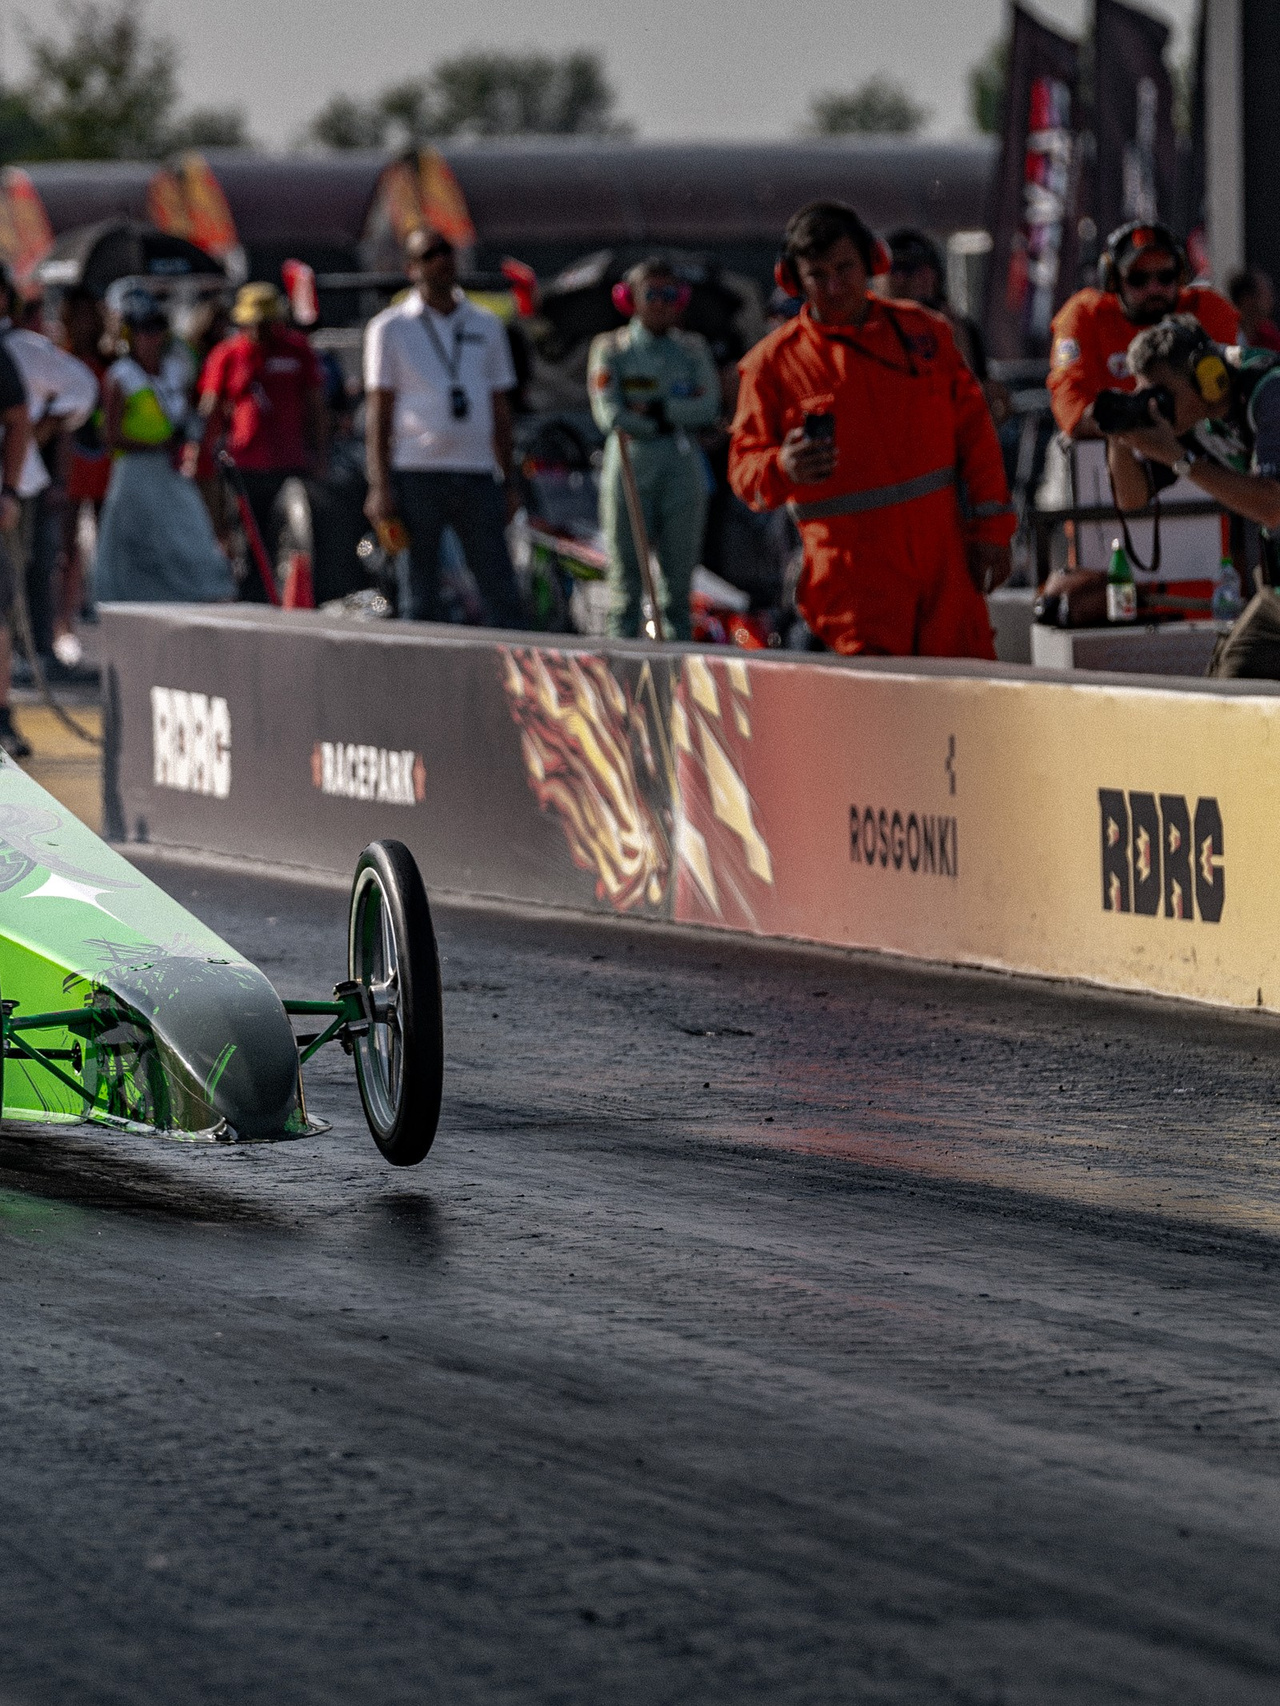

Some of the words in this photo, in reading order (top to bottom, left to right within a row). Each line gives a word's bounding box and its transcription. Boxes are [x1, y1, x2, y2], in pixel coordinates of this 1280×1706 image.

[150, 685, 232, 800] RDRC
[321, 741, 417, 807] RACEPARK
[848, 803, 959, 879] ROSGONKI
[1098, 786, 1226, 924] RDRC
